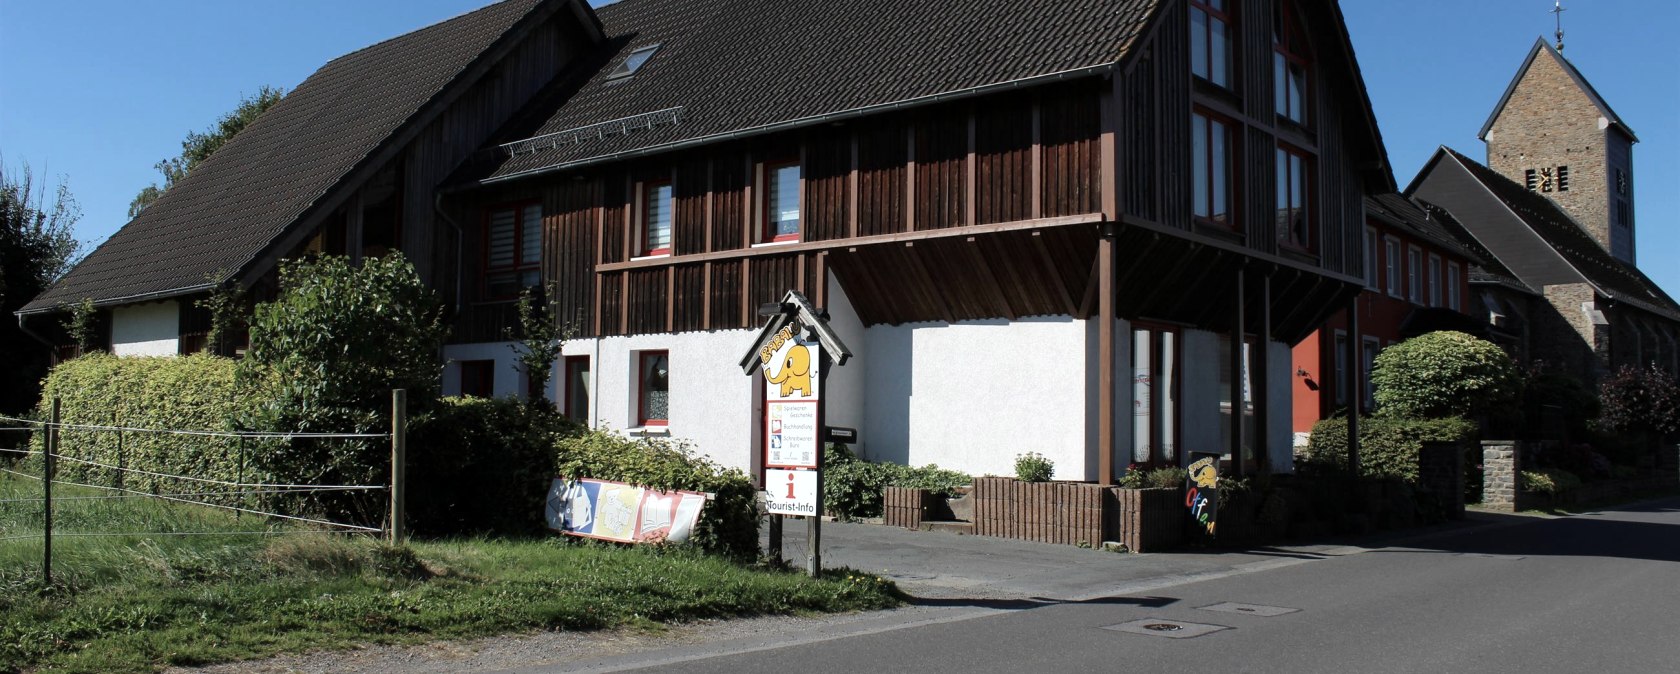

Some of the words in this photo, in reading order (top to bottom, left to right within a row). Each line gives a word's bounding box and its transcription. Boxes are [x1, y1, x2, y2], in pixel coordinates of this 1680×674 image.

[783, 423, 813, 431] Buchhandlung
[768, 500, 814, 512] Tourist-Info
[1186, 487, 1215, 535] Offen
